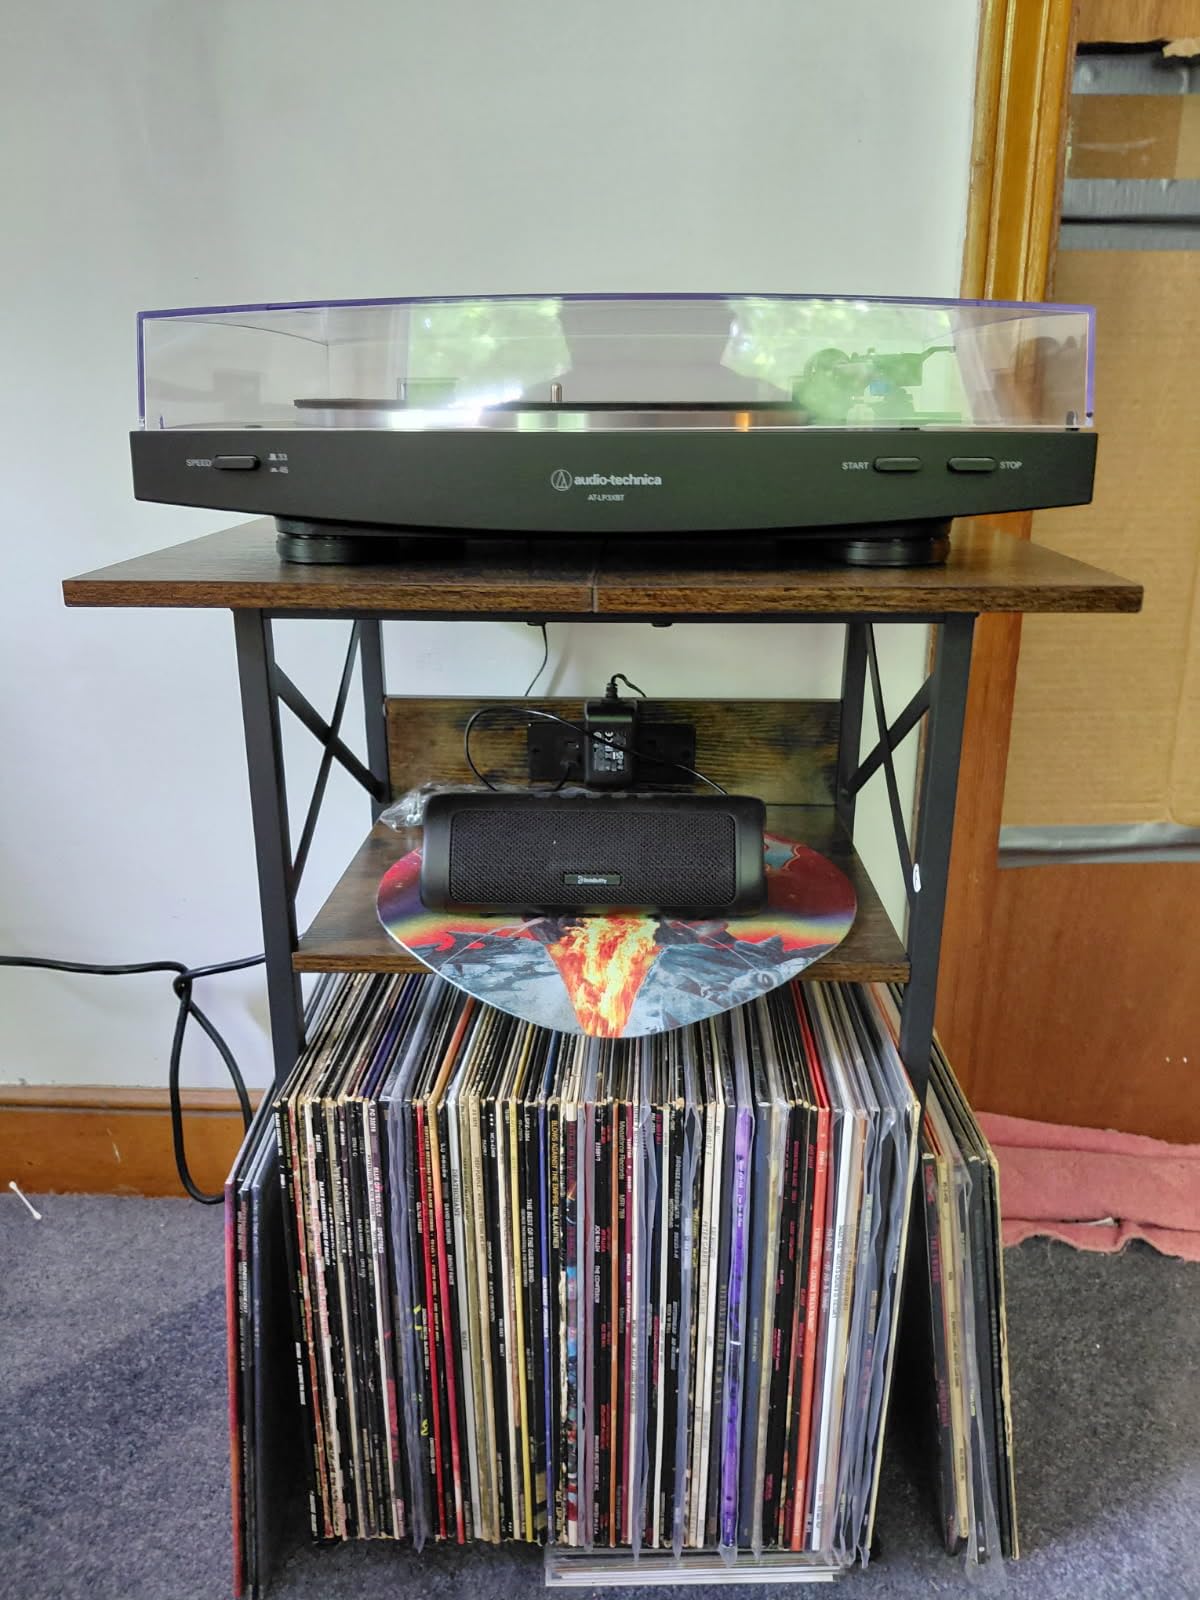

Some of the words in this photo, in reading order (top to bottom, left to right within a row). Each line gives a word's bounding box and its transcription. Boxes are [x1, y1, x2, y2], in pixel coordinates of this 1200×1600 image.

[186, 459, 212, 467] SPEED
[841, 462, 869, 470] START
[999, 462, 1023, 470] STOP
[574, 474, 662, 486] audio-technica
[527, 1227, 533, 1236] OF
